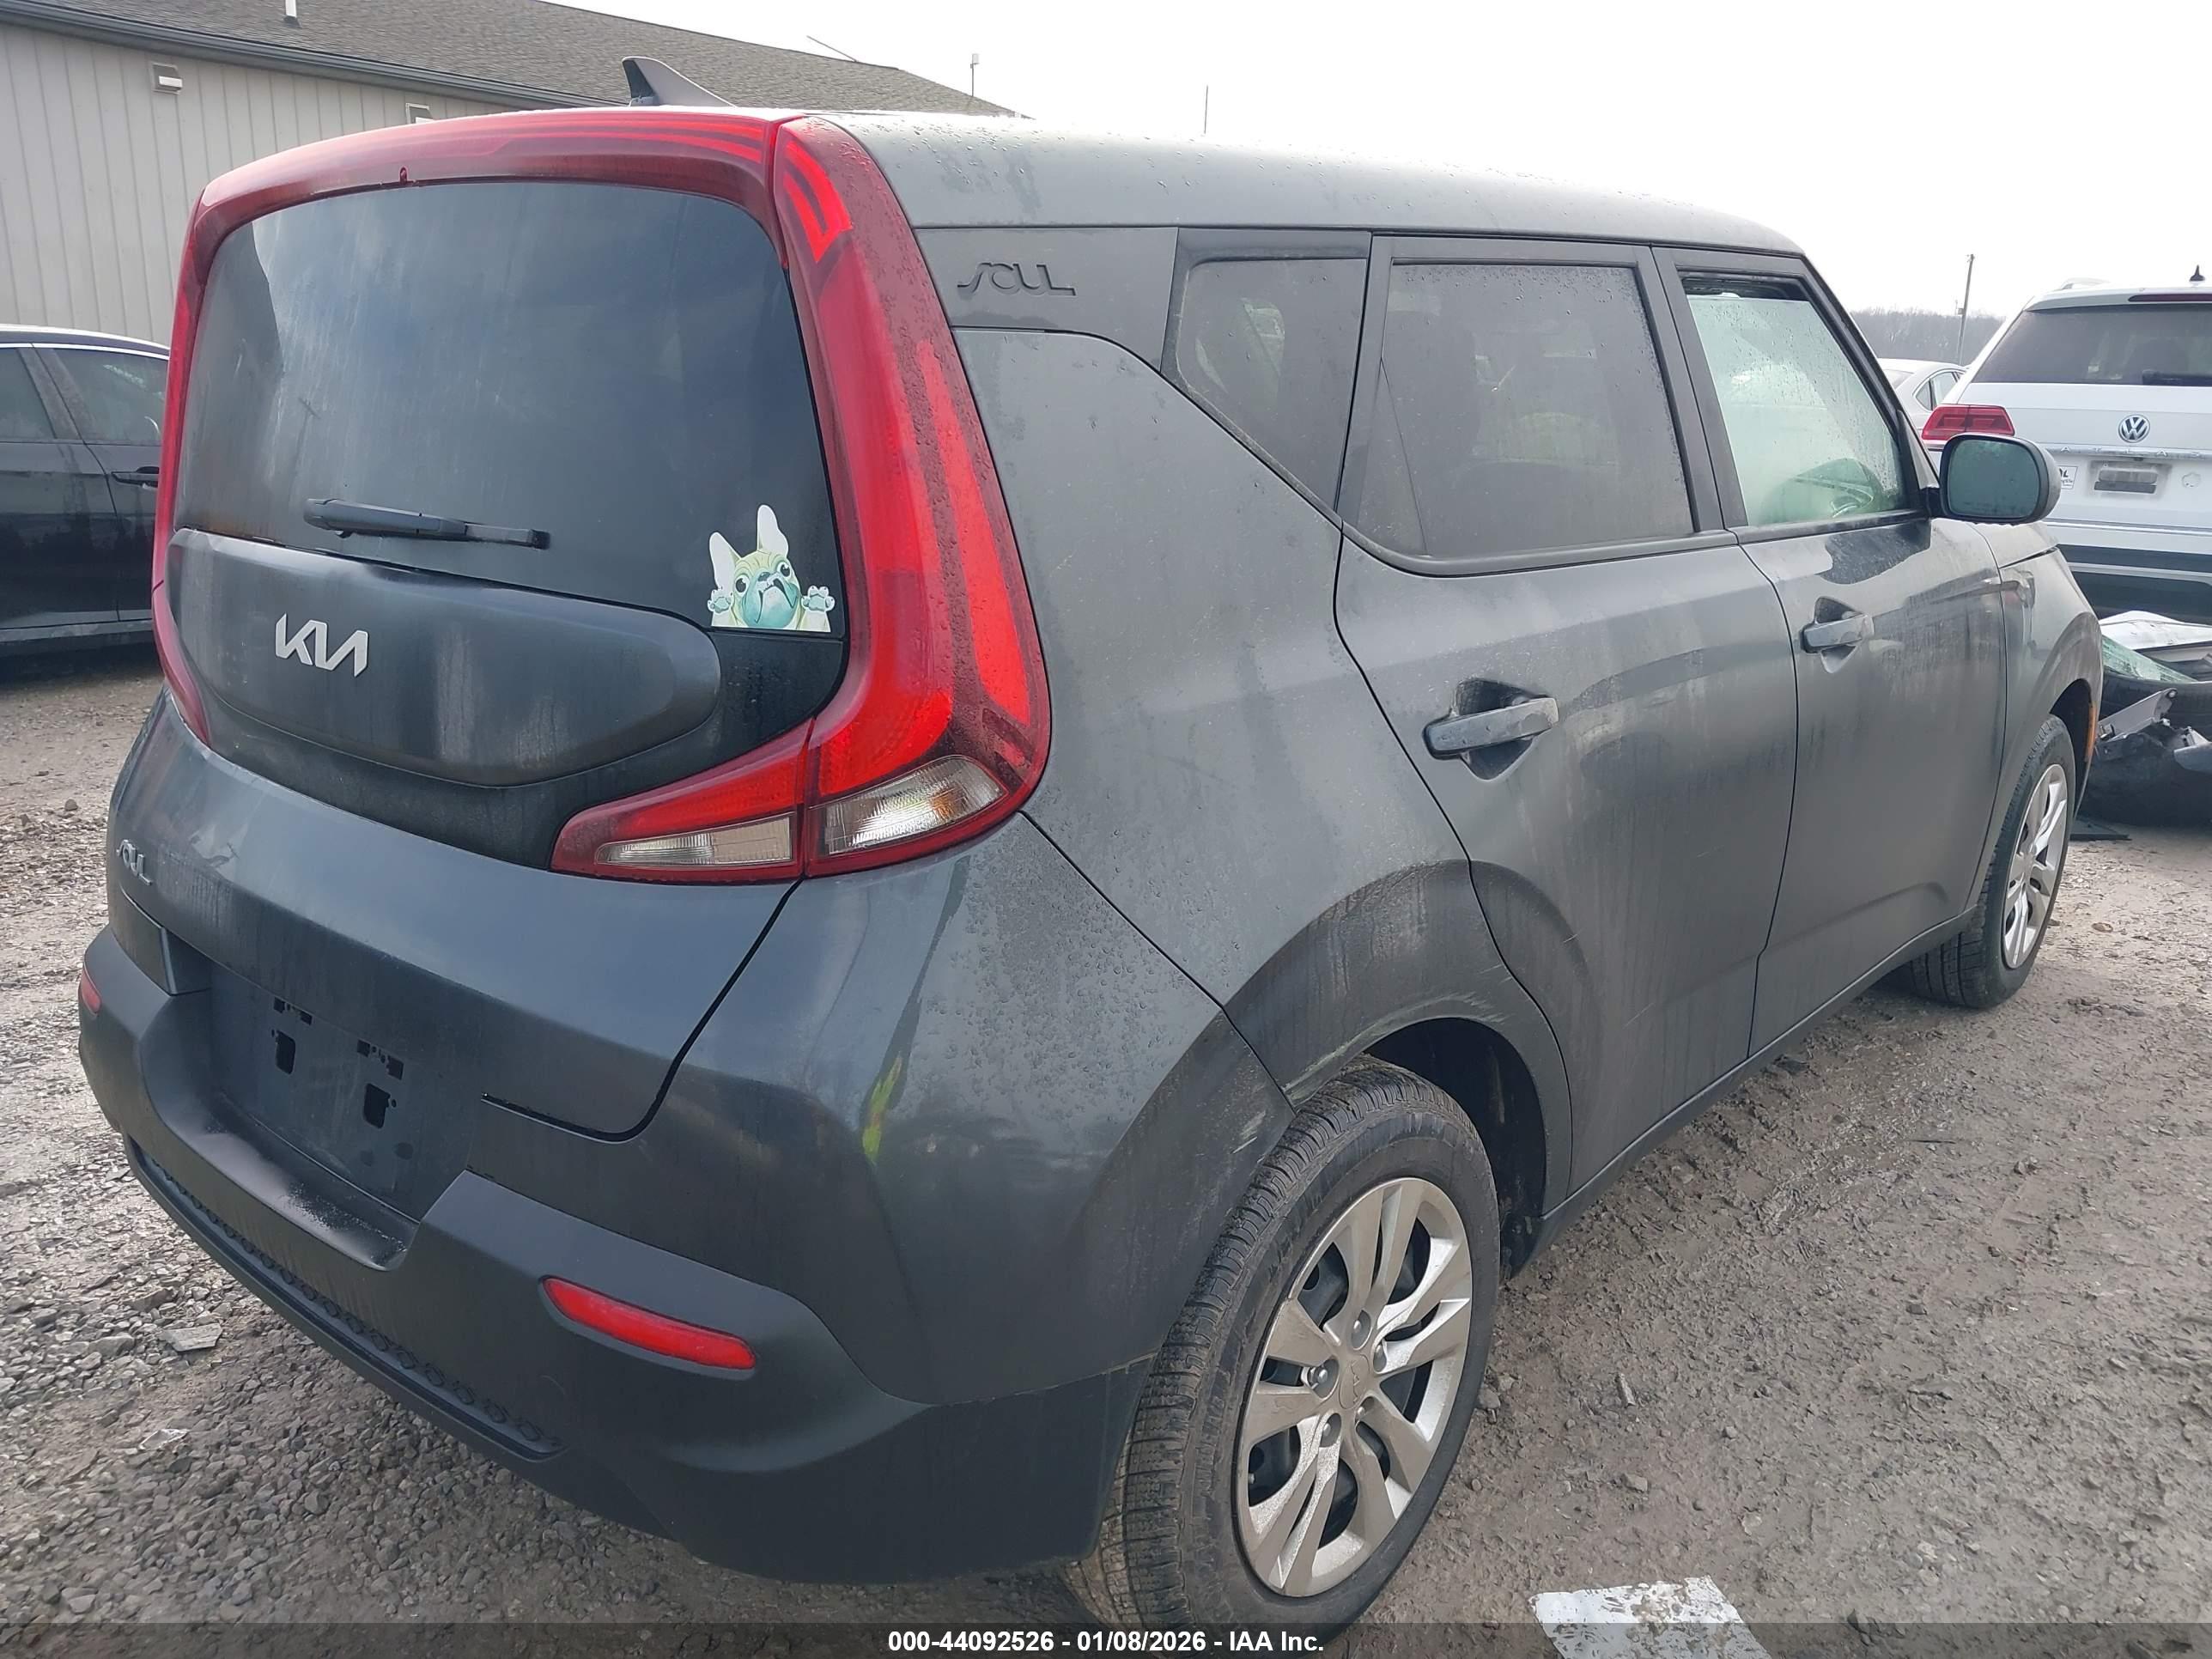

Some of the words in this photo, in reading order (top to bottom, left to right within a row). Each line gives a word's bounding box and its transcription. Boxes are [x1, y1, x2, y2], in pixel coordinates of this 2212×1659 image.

[957, 262, 1077, 300] SOUL
[275, 612, 368, 678] KIA
[116, 839, 152, 886] SOUL
